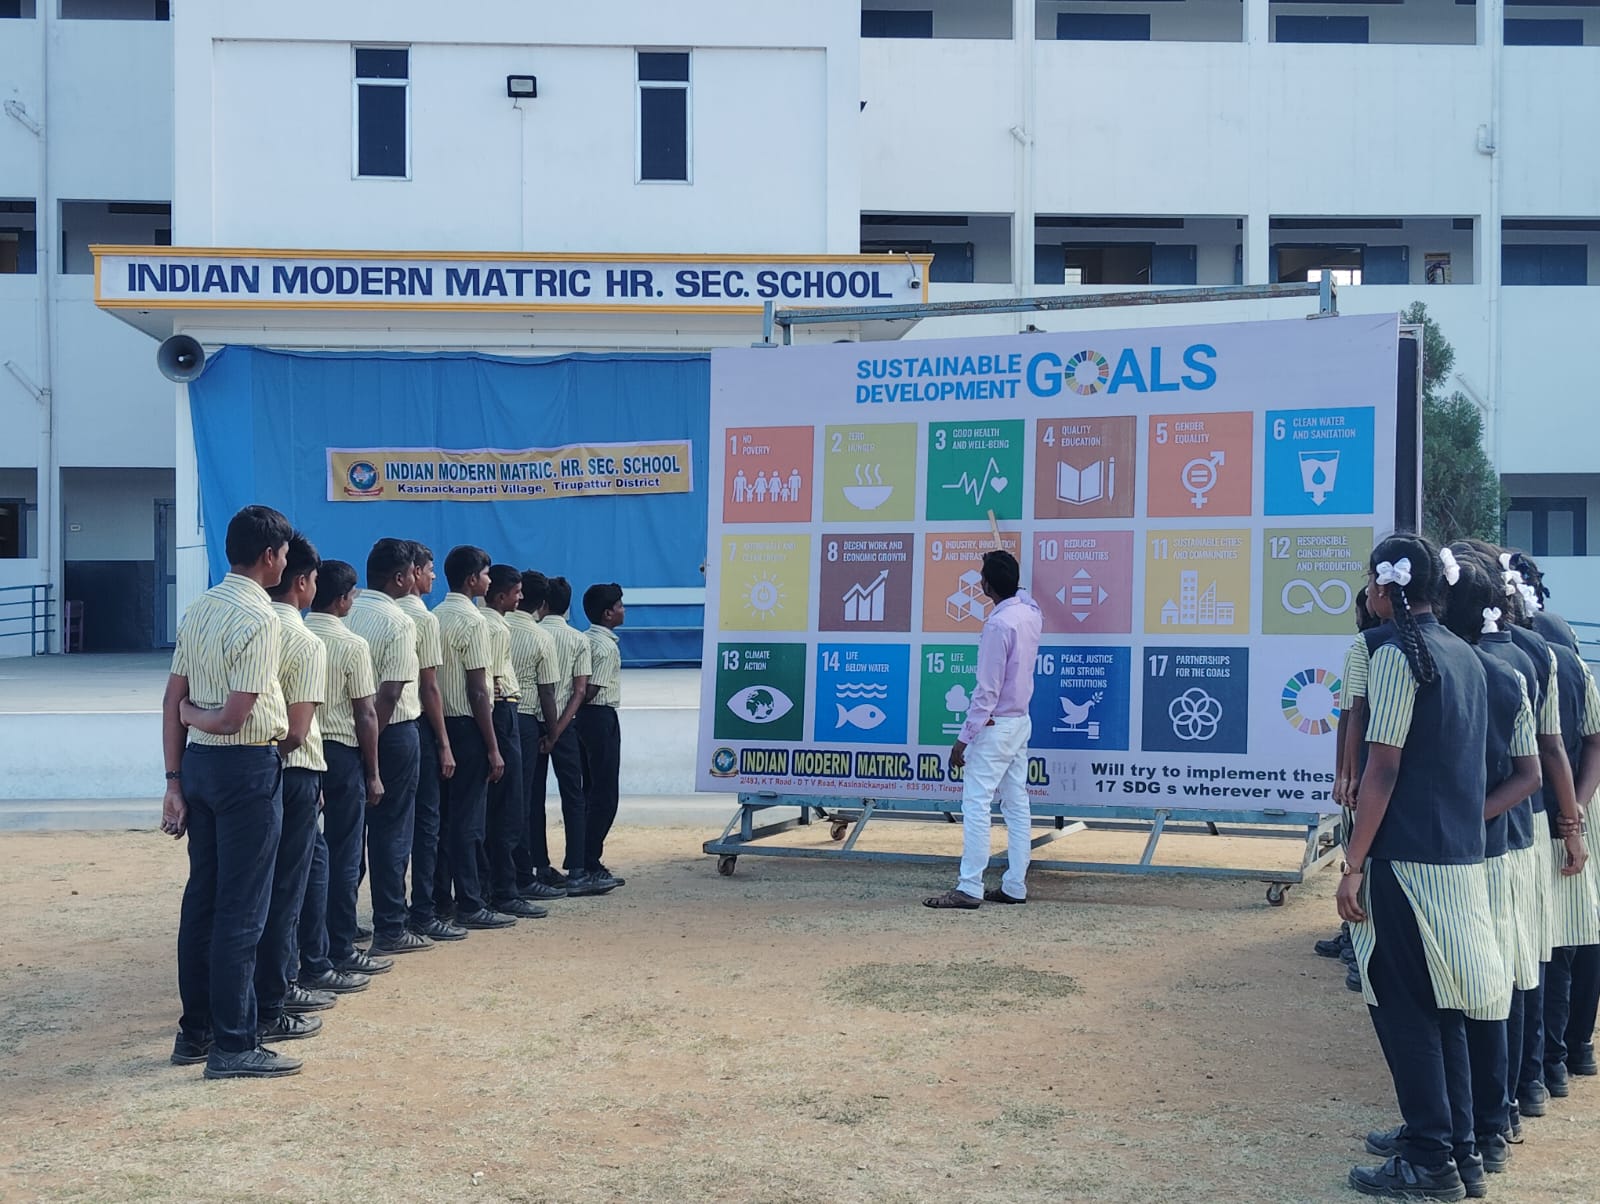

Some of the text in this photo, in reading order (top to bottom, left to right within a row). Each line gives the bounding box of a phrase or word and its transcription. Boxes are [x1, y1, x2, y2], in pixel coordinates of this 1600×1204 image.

[128, 263, 892, 298] INDIAN MODERN MATRIC HR. SEC. SCHOOL
[857, 354, 1021, 379] SUSTAINABLE
[1026, 344, 1217, 397] GOALS
[856, 379, 1021, 403] DEVELOPMENT
[1175, 422, 1204, 431] GENDER
[1293, 416, 1345, 427] CLEAN WATER
[953, 428, 1000, 438] GOOD HEALTH
[1062, 425, 1092, 435] QUALITY
[1156, 423, 1168, 444] 5
[1273, 419, 1286, 440] 6
[1293, 428, 1356, 440] AND SANITATION
[743, 435, 752, 443] NO
[832, 432, 842, 452] 2
[935, 429, 946, 450] 3
[1043, 426, 1055, 447] 4
[1062, 437, 1101, 447] EDUCATION
[1175, 433, 1210, 444] EQUALITY
[730, 435, 737, 455] 1
[743, 446, 771, 455] POVERTY
[952, 440, 1009, 450] AND WELL-BEING
[386, 463, 433, 480] INDIAN
[439, 463, 496, 481] MODERN
[501, 461, 557, 481] MATRIC.
[561, 459, 583, 476] HR.
[588, 458, 619, 475] SEC.
[624, 456, 680, 473] SCHOOL
[398, 478, 660, 495] Kasinaickanpatti Village, Tirupattur District
[843, 540, 903, 550] DECENT WORK AND
[1064, 539, 1096, 548] REDUCED
[1173, 536, 1243, 547] SUSTAINABLE CITIES
[1297, 536, 1347, 546] RESPONSIBLE
[728, 543, 736, 561] 7
[827, 541, 838, 562] 8
[931, 541, 943, 561] 9
[1039, 540, 1058, 561] 10
[1152, 538, 1168, 560] 11
[1270, 537, 1291, 559] 12
[843, 552, 906, 562] ECONOMIC GROWTH
[945, 552, 959, 561] AND
[1063, 552, 1110, 561] INEQUALITIES
[1173, 549, 1238, 560] AND COMMUNITIES
[1296, 549, 1351, 559] CONSUMPTION
[1296, 561, 1363, 571] AND PRODUCTION
[722, 650, 739, 670] 13
[744, 650, 770, 659] CLIMATE
[846, 652, 859, 660] LIFE
[951, 653, 964, 662] LIFE
[1061, 654, 1113, 665] PEACE, JUSTICE
[1176, 655, 1230, 665] PARTNERSHIPS
[744, 661, 767, 671] ACTION
[822, 651, 840, 671] 14
[926, 652, 945, 673] 15
[1036, 654, 1055, 675] 16
[1149, 655, 1169, 677] 17
[845, 663, 890, 673] BELOW WATER
[951, 664, 960, 673] ON
[1061, 667, 1105, 676] AND STRONG
[1176, 668, 1230, 677] FOR THE GOALS
[1060, 679, 1107, 688] INSTITUTIONS
[743, 751, 787, 773] INDIAN
[794, 752, 849, 775] MODERN
[858, 753, 912, 778] MATRIC.
[920, 754, 943, 779] HR.
[1092, 763, 1334, 783] Will try to implement thes
[775, 778, 791, 786] Road
[1096, 780, 1116, 793] 17
[1123, 781, 1161, 794] SDG
[1183, 783, 1270, 798] wherever
[1277, 789, 1305, 800] we
[1311, 789, 1331, 801] ar
